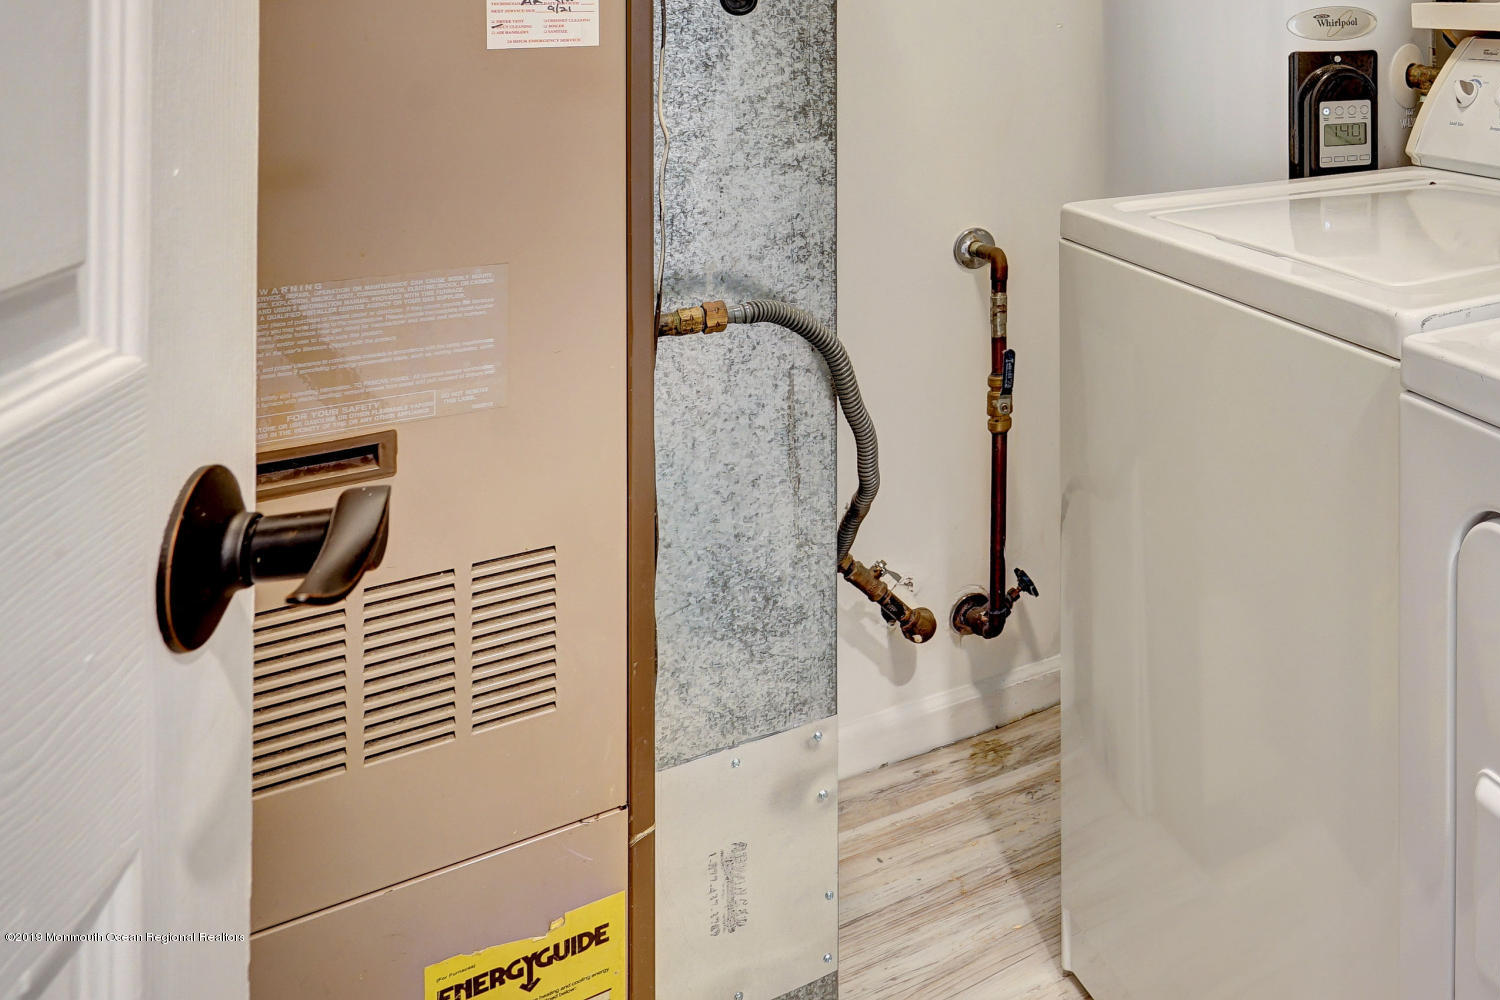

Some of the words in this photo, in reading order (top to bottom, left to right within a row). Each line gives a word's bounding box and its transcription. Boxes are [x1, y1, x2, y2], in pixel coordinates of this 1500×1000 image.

[1316, 16, 1359, 28] Whirlpool
[259, 283, 322, 295] WARNING
[286, 412, 308, 422] FOR
[311, 408, 339, 418] YOUR
[342, 402, 380, 414] SAFETY
[436, 922, 610, 1000] ENERGYGUIDE
[560, 982, 572, 992] and
[571, 974, 592, 988] cooling
[591, 967, 610, 980] energy
